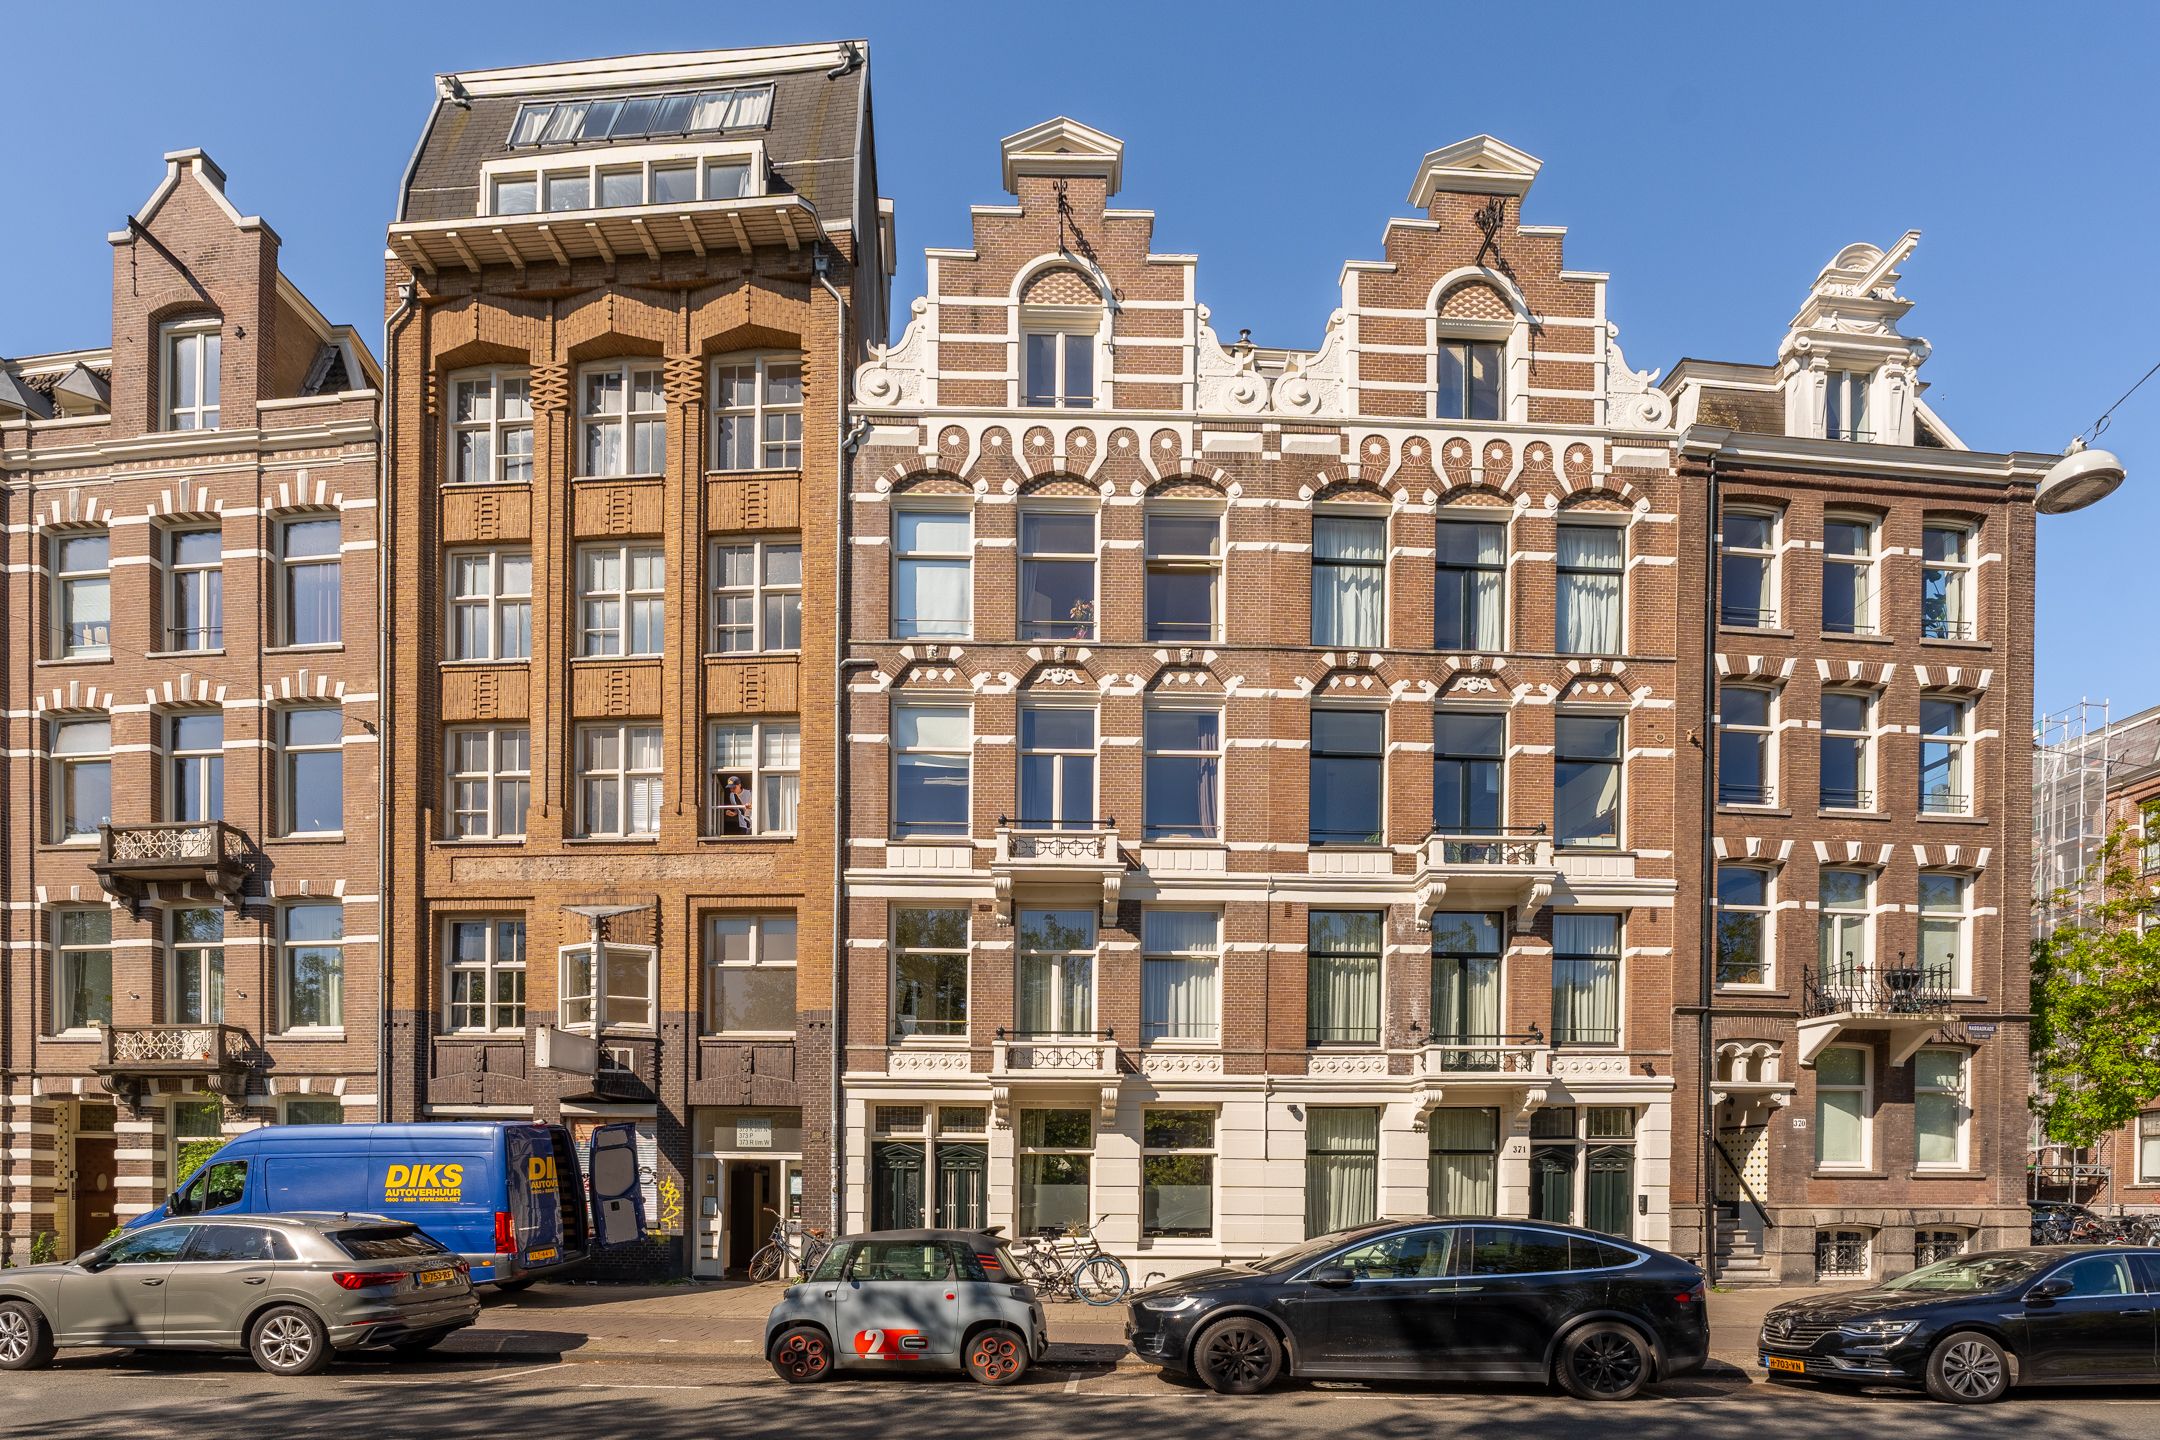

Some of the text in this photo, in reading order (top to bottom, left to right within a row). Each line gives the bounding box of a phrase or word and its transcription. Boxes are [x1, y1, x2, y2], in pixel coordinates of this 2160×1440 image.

[1513, 1145, 1526, 1154] 371
[385, 1164, 464, 1188] DIKS
[385, 1188, 461, 1197] AUTOVERHUUR
[864, 1329, 885, 1360] 2
[1770, 1358, 1801, 1371] H-703-VN
